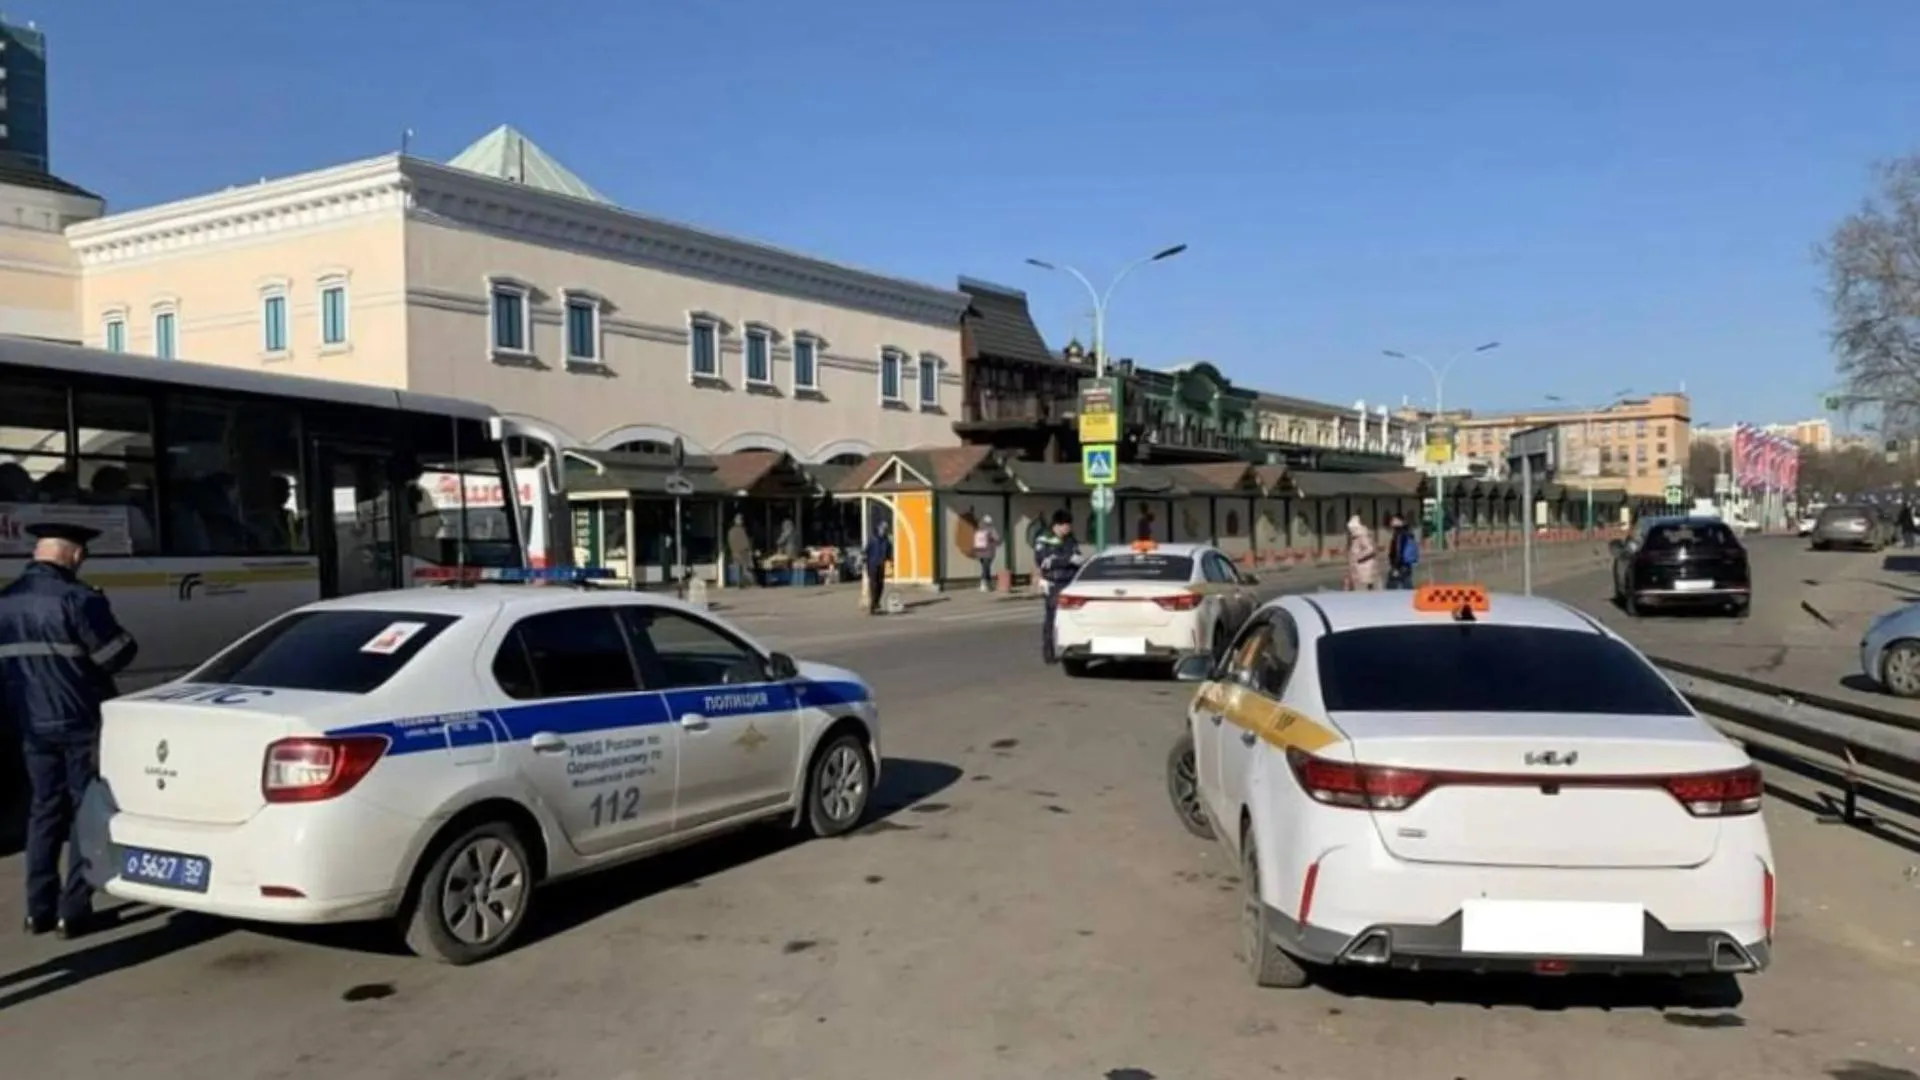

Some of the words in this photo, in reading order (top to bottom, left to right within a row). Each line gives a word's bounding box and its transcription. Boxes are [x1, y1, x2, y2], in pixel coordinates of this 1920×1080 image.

[703, 691, 769, 710] ПОЛИЦИЯ
[605, 737, 645, 752] России
[590, 786, 641, 828] 112
[139, 853, 178, 880] 5627
[185, 859, 204, 877] 50
